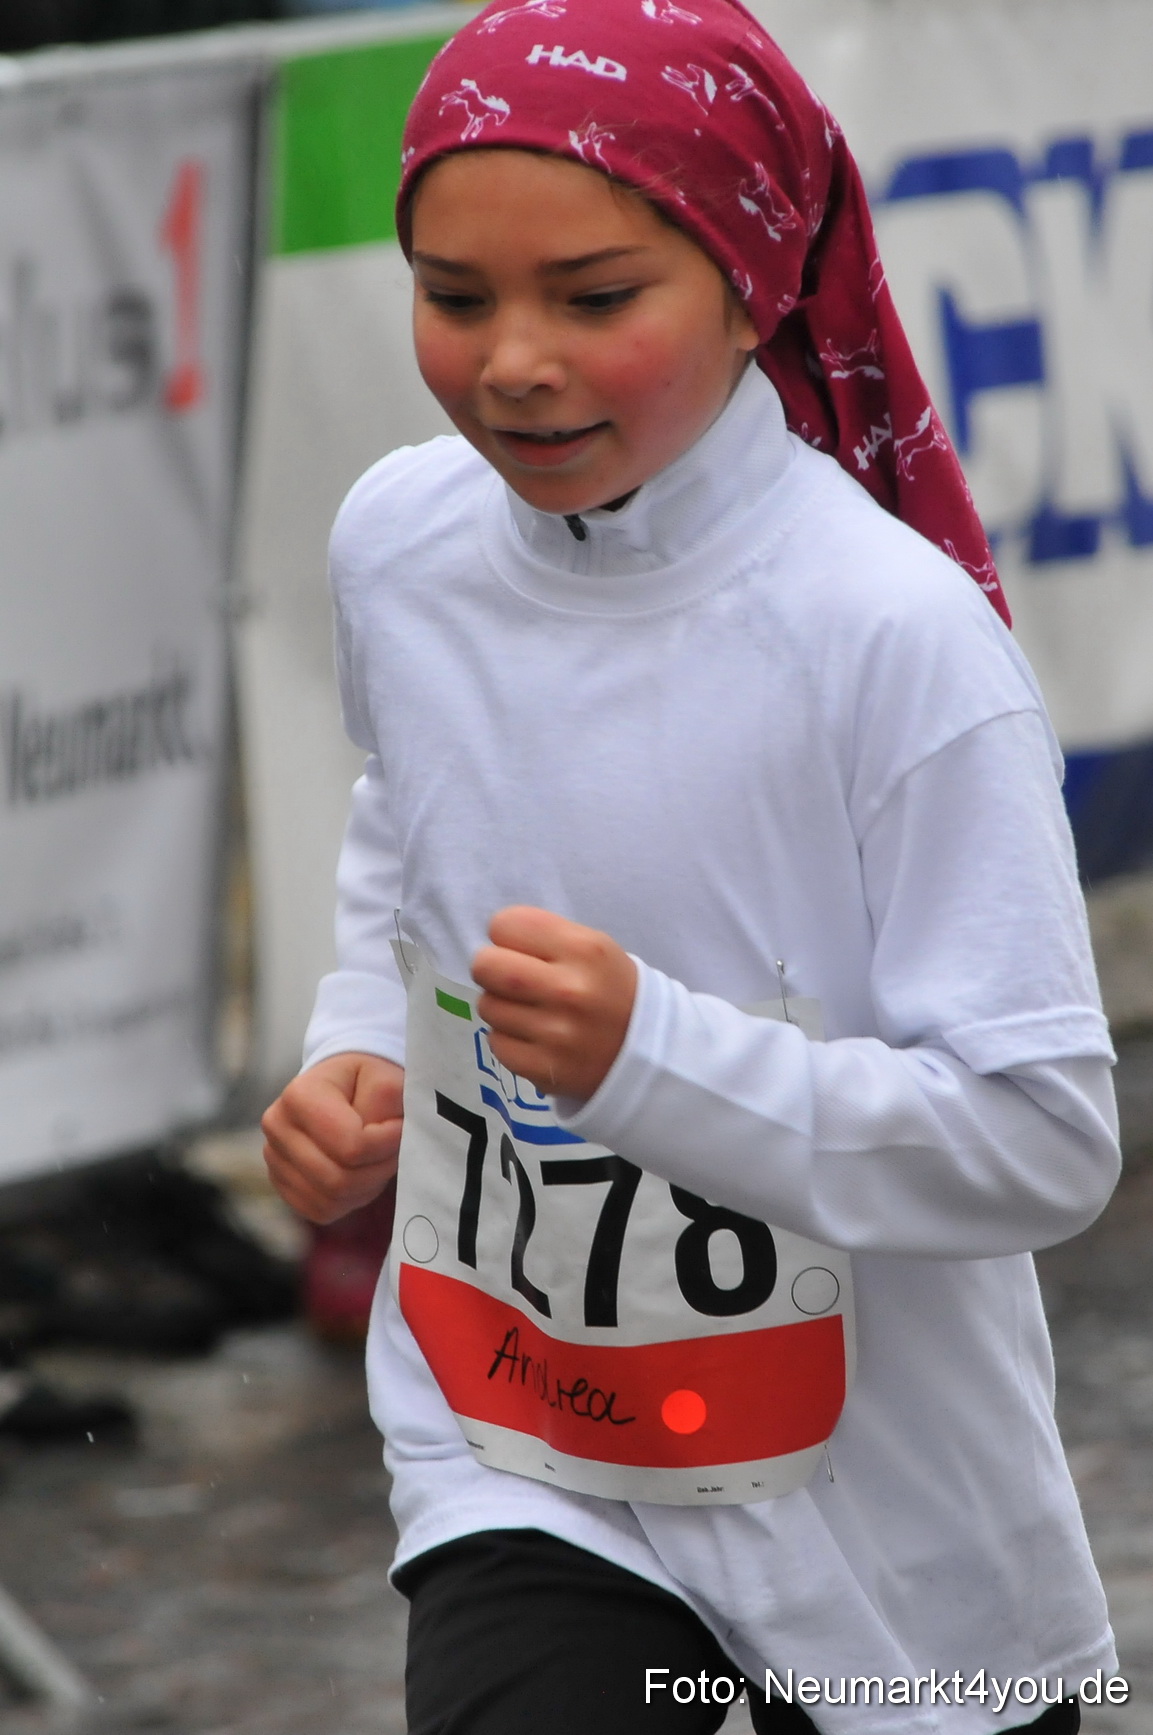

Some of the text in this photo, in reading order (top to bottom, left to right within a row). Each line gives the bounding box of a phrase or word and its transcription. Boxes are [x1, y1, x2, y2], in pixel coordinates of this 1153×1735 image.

[525, 44, 627, 82] HAD
[853, 412, 893, 471] HA
[434, 1089, 778, 1327] 7278
[487, 1327, 636, 1425] Andrea
